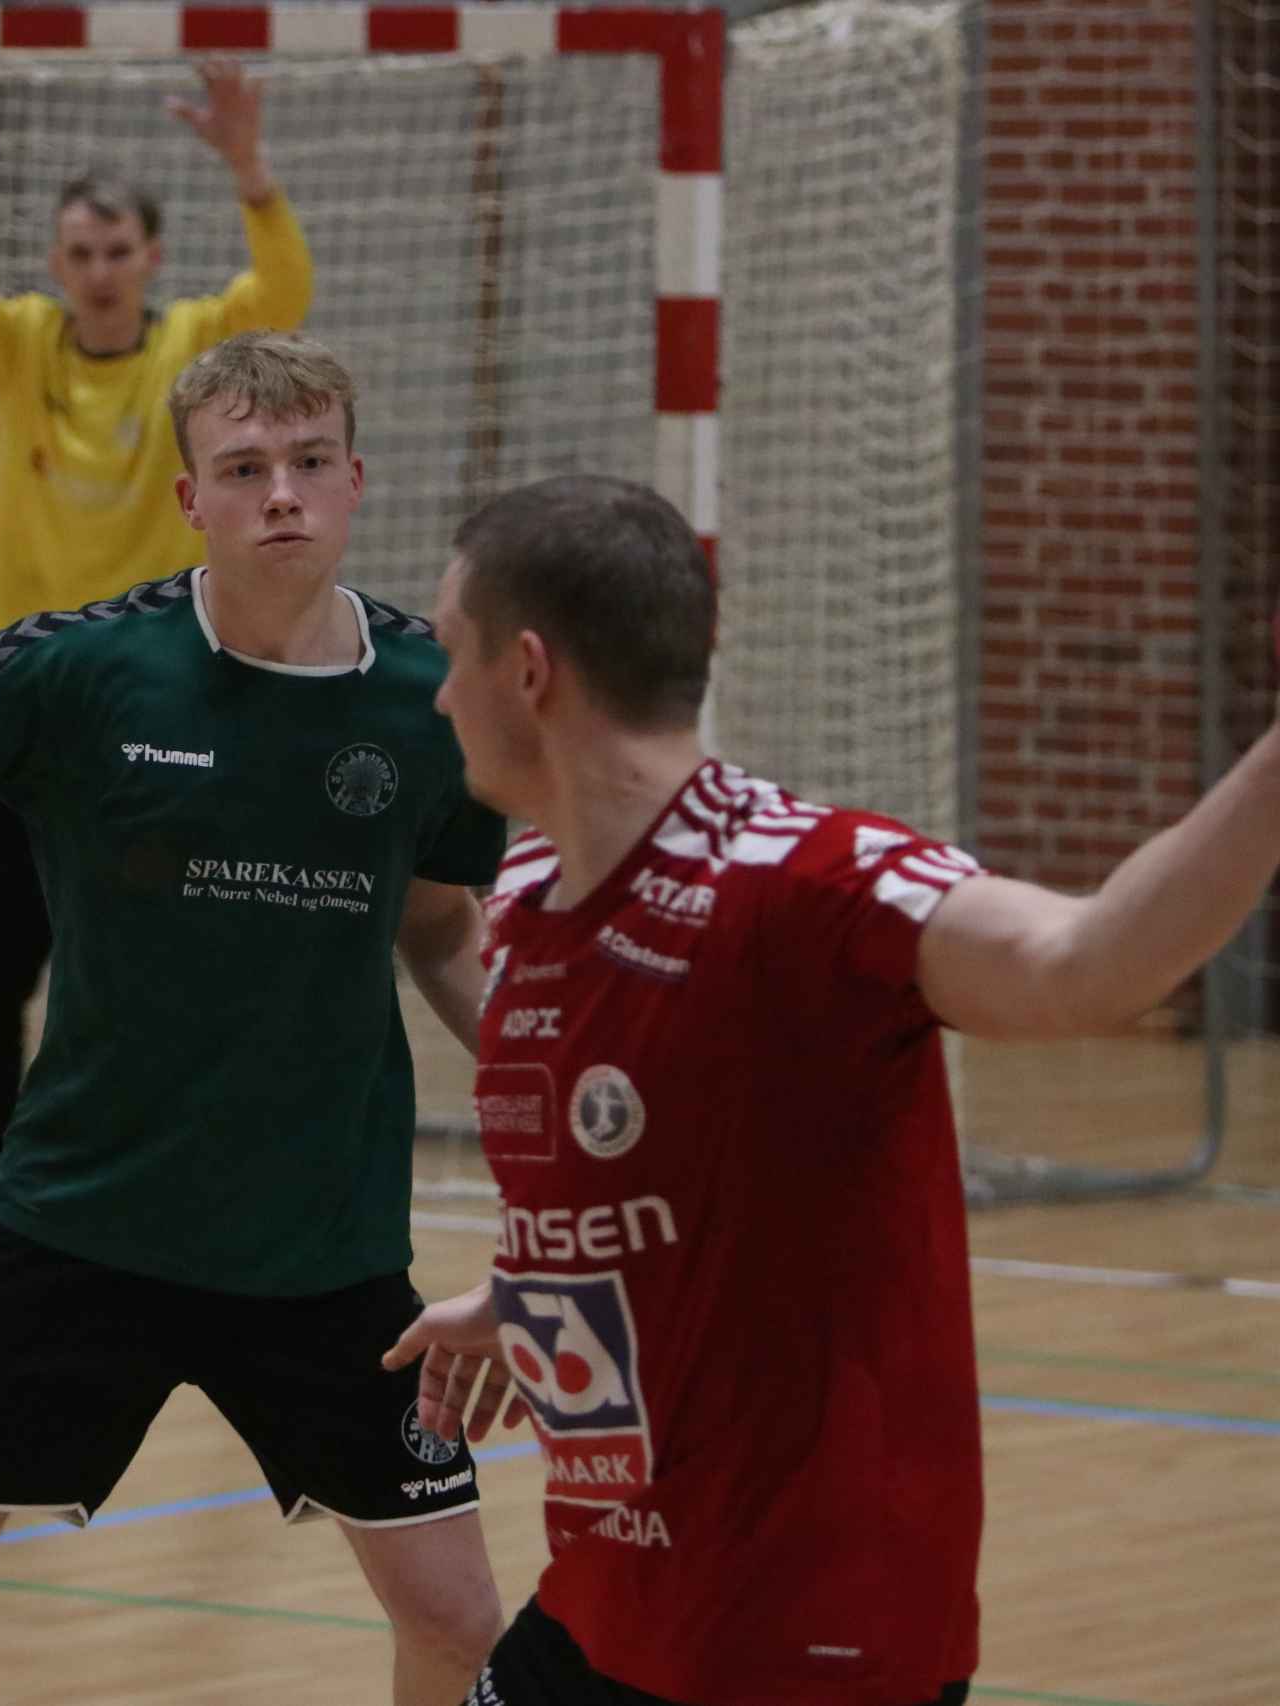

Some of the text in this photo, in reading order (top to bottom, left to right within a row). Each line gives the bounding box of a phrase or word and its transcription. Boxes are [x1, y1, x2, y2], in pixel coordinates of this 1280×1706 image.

[144, 743, 214, 768] hummel
[186, 858, 376, 894] SPAREKASSEN
[181, 883, 204, 897] for
[254, 888, 299, 907] Nebel
[301, 898, 319, 912] og
[319, 894, 370, 913] Omegn
